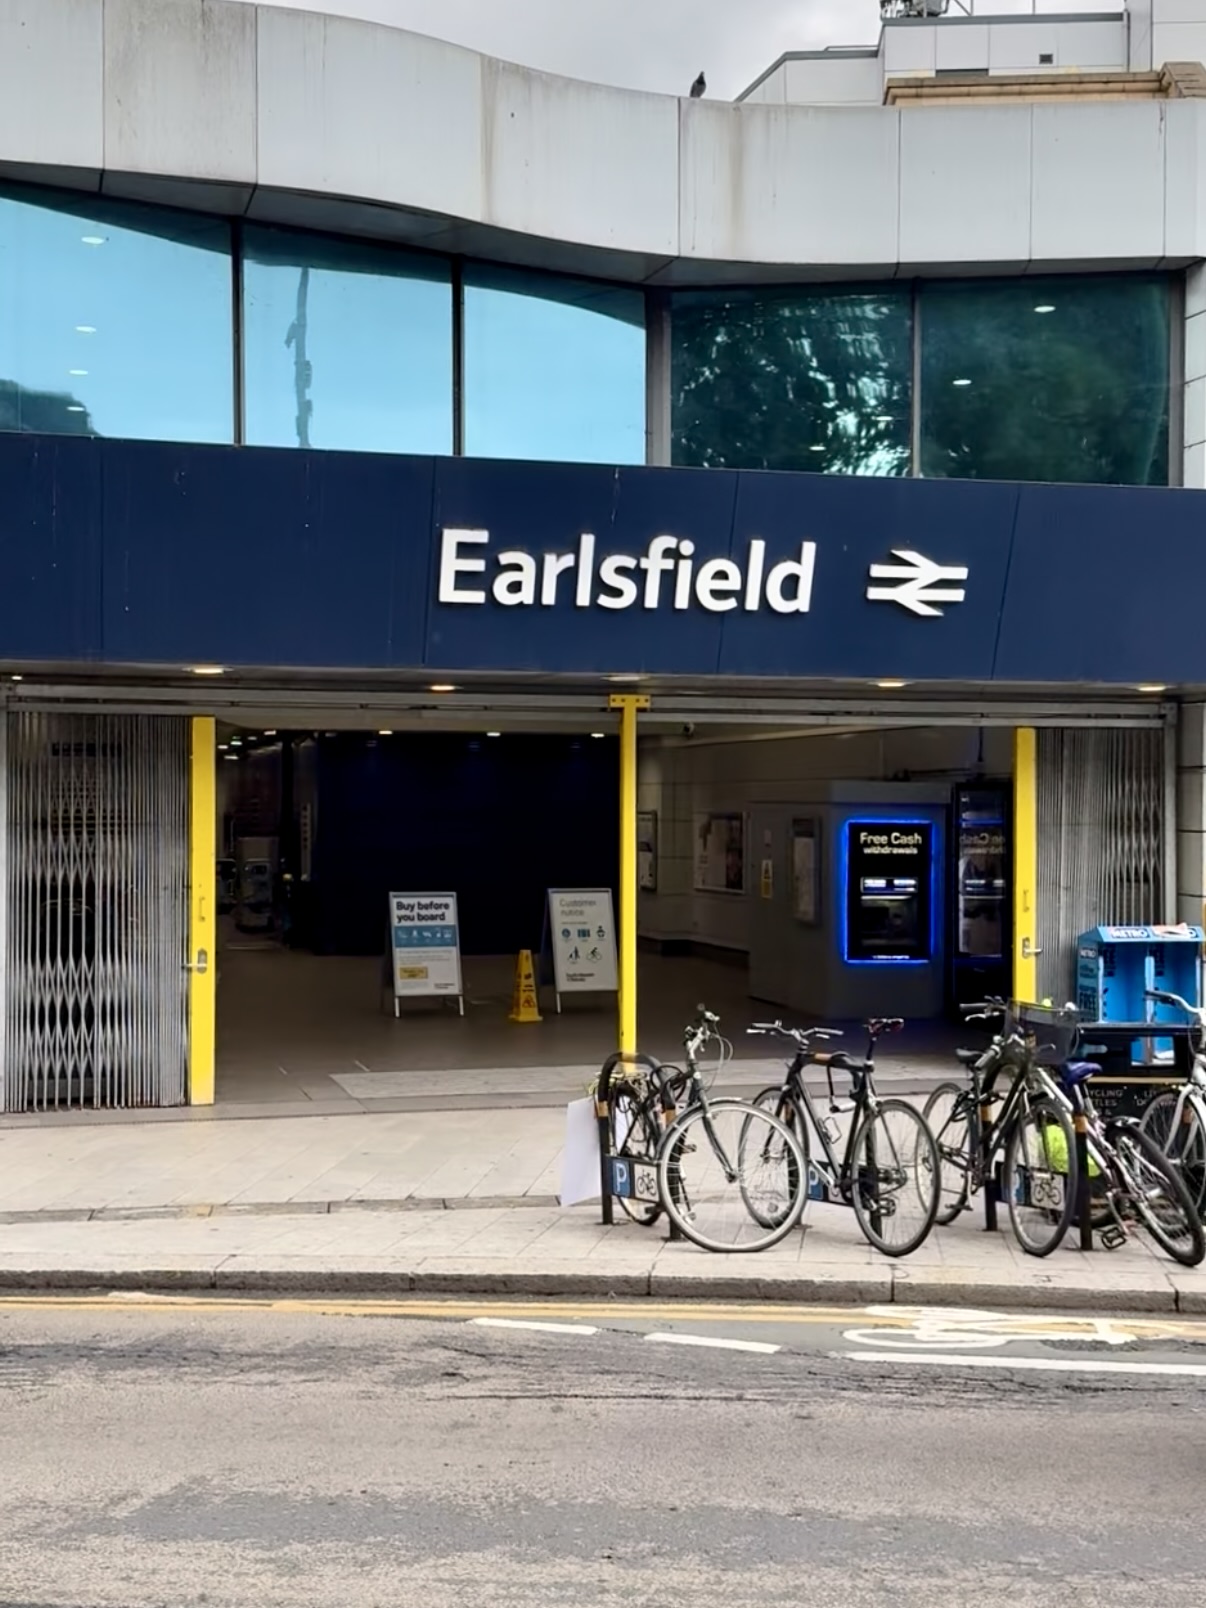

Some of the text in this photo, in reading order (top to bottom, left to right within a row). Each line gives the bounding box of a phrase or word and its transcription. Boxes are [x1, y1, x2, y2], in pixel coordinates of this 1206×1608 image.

[439, 528, 816, 613] Earlsfield
[860, 832, 922, 844] Free Cash
[863, 845, 918, 855] withdrawals
[396, 901, 450, 912] Buy before
[396, 912, 446, 924] you board
[1111, 928, 1148, 939] METRO
[615, 1162, 627, 1192] P
